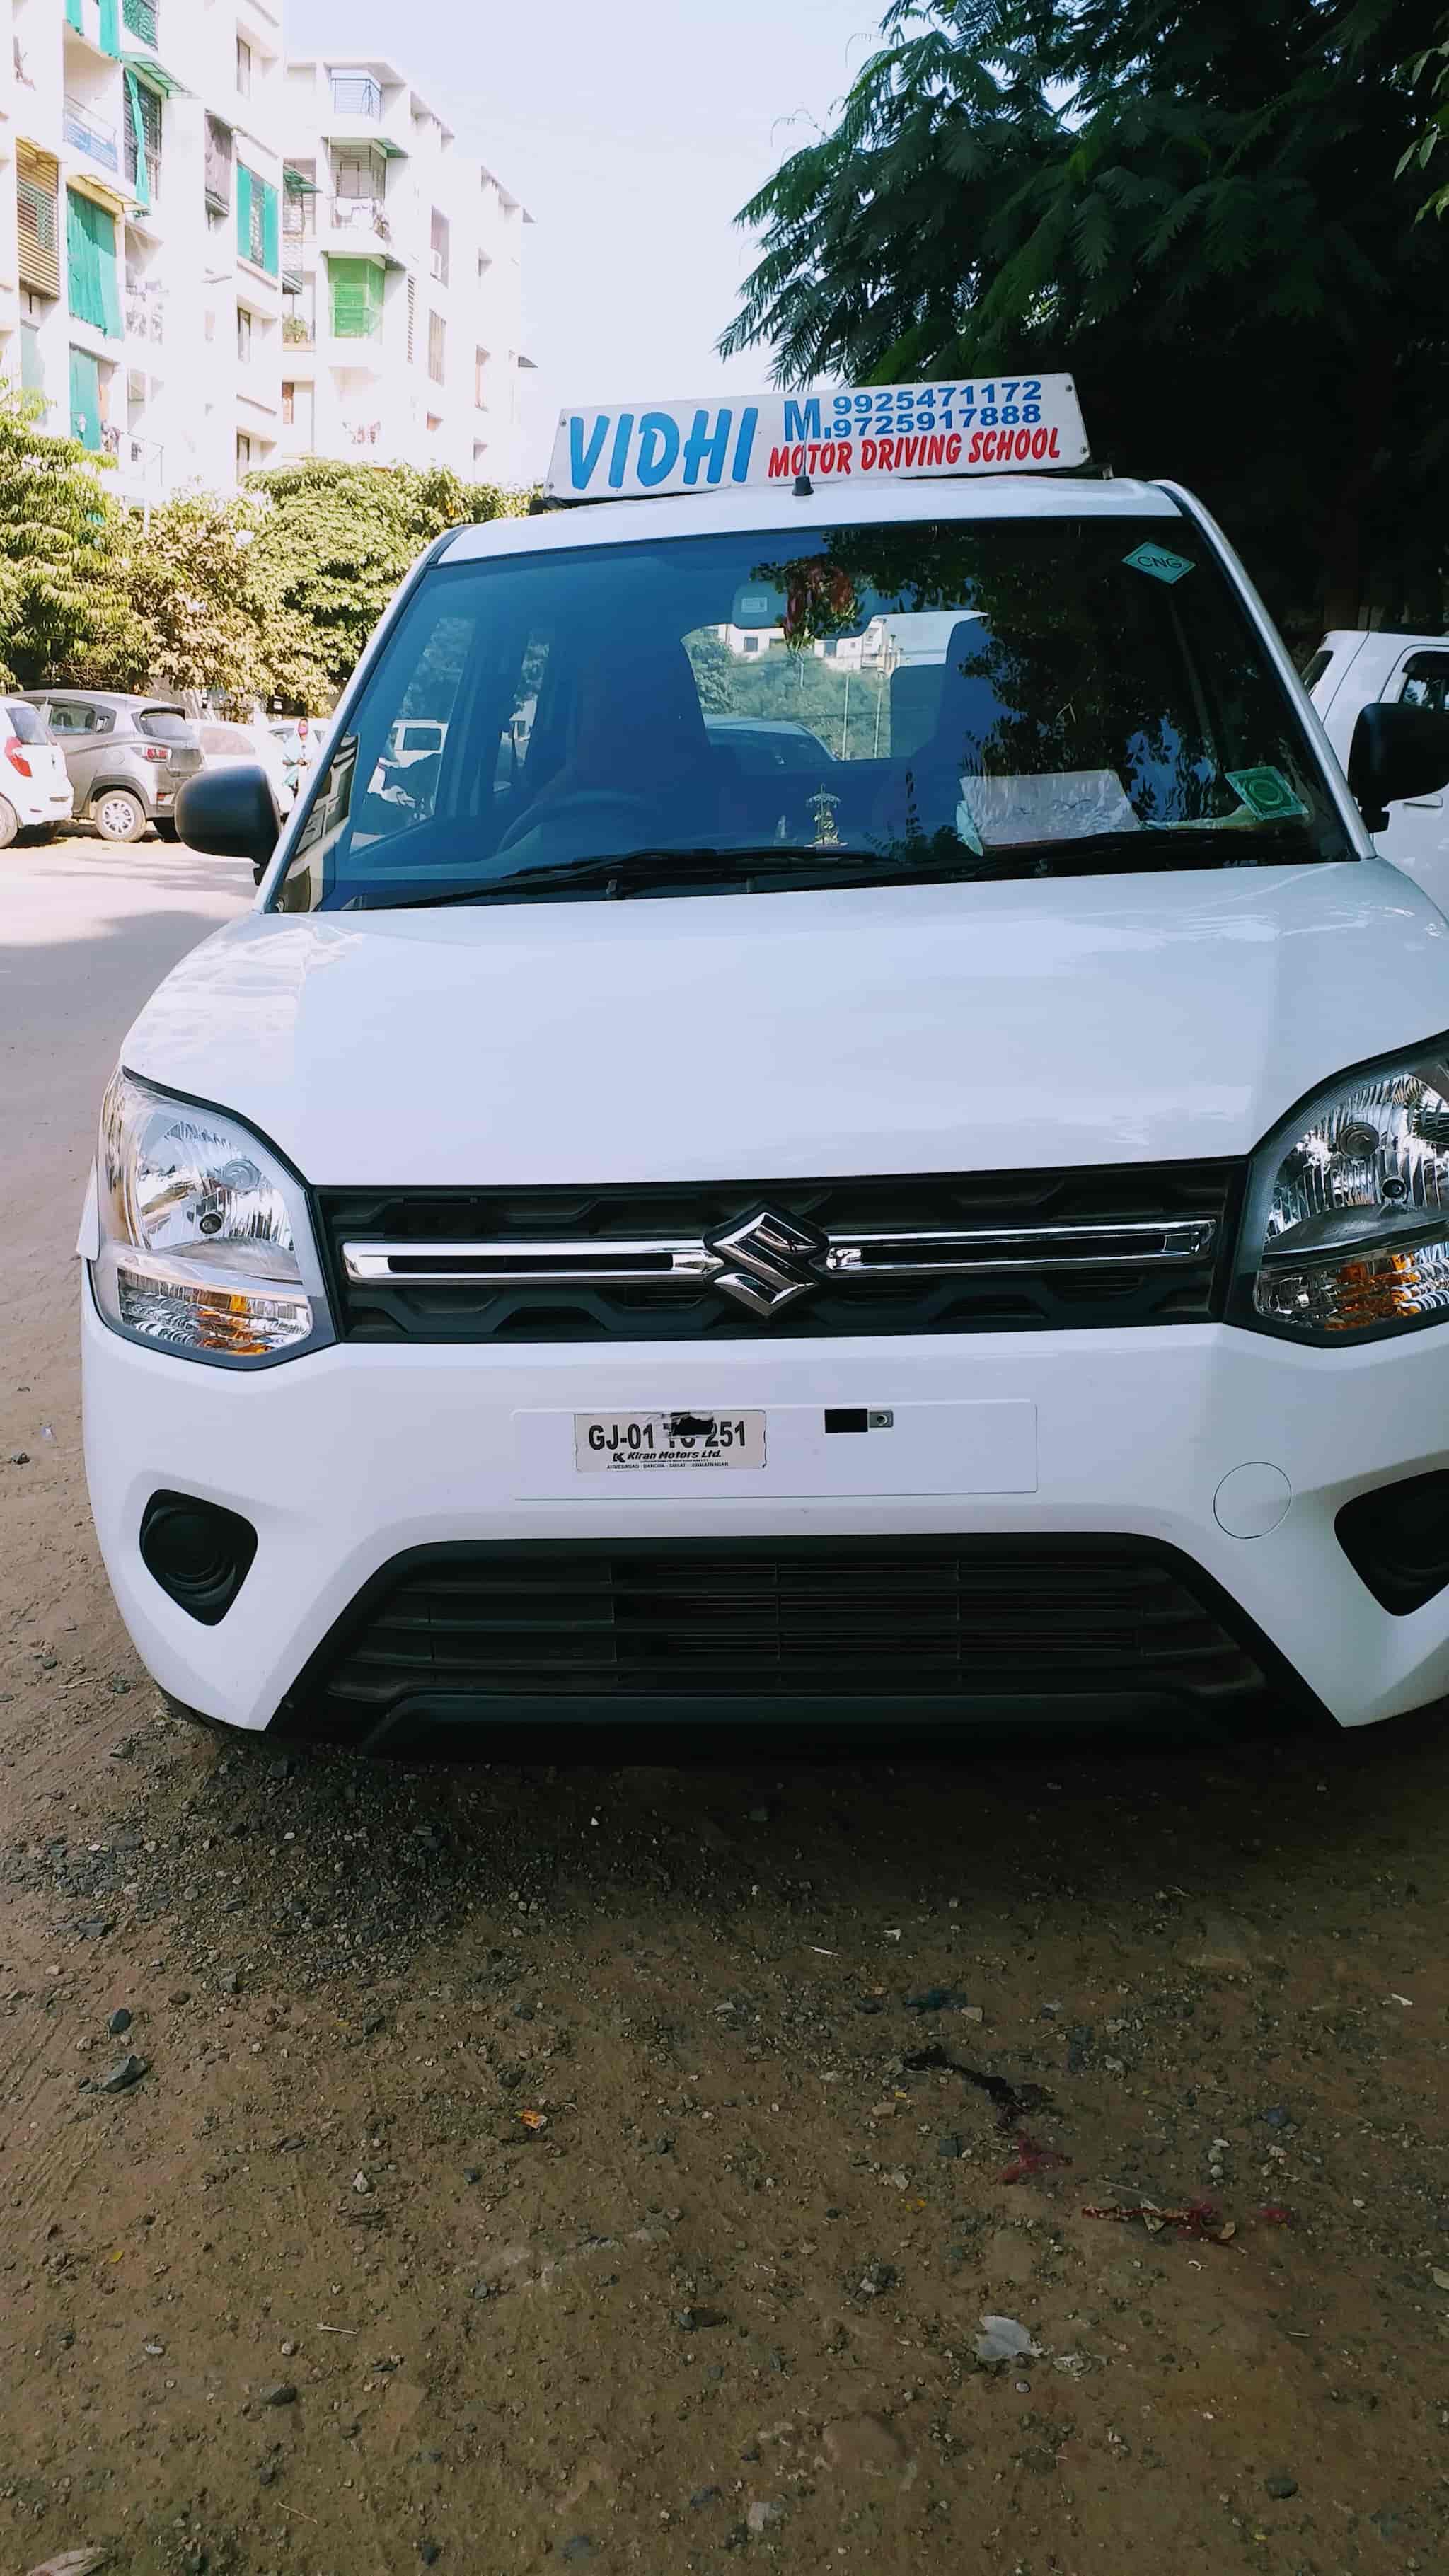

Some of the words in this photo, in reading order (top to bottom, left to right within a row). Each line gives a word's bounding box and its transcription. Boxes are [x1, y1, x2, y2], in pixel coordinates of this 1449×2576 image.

[833, 381, 1042, 415] 9925471172
[833, 403, 1042, 439] 9725917888
[570, 407, 759, 490] VIDHI
[768, 441, 852, 478] MOTOR
[861, 433, 962, 471] DRIVING
[968, 427, 1061, 463] SCHOOL
[1137, 556, 1182, 568] CNG
[589, 1423, 654, 1450] GJ-01
[705, 1420, 746, 1448] 251
[659, 1451, 699, 1460] Motors
[701, 1450, 722, 1458] Ltd.
